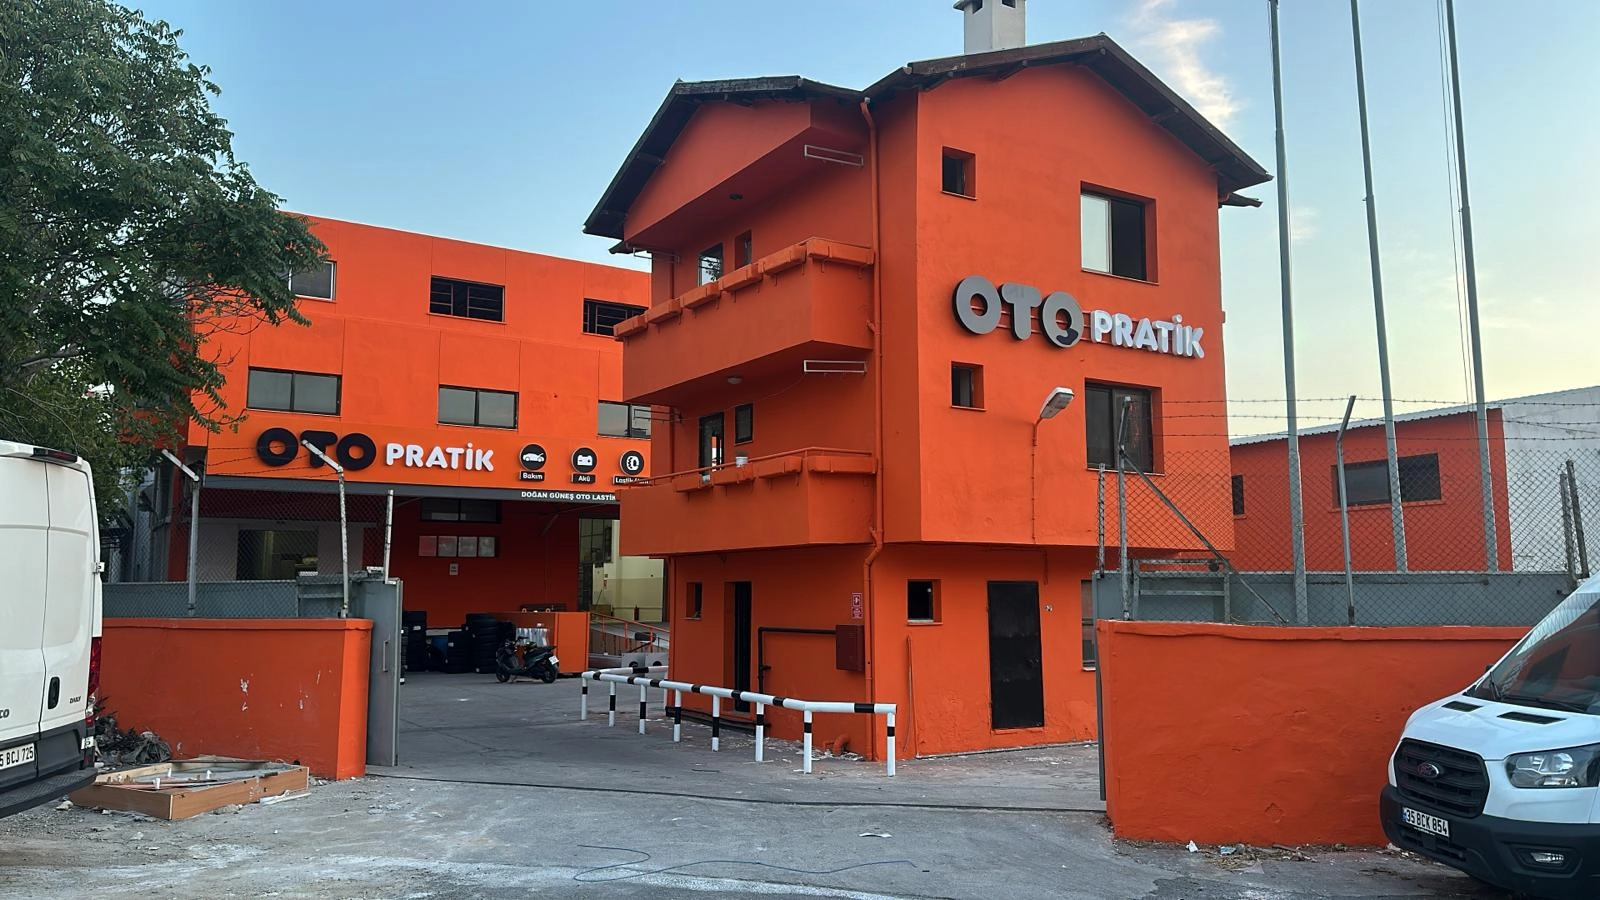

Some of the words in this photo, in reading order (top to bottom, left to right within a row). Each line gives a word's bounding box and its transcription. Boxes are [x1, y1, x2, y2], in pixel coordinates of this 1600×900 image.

[952, 275, 1083, 349] OTO
[1090, 310, 1205, 358] PRATİK
[256, 427, 376, 471] OTO
[386, 442, 494, 471] PRATİK
[521, 491, 548, 499] DOĞAN
[549, 492, 574, 501] GÜNEŞ
[6, 749, 20, 765] BCJ
[22, 746, 34, 761] 725
[1406, 809, 1416, 823] 35
[1417, 812, 1431, 830] BCK
[1432, 817, 1447, 834] 854
